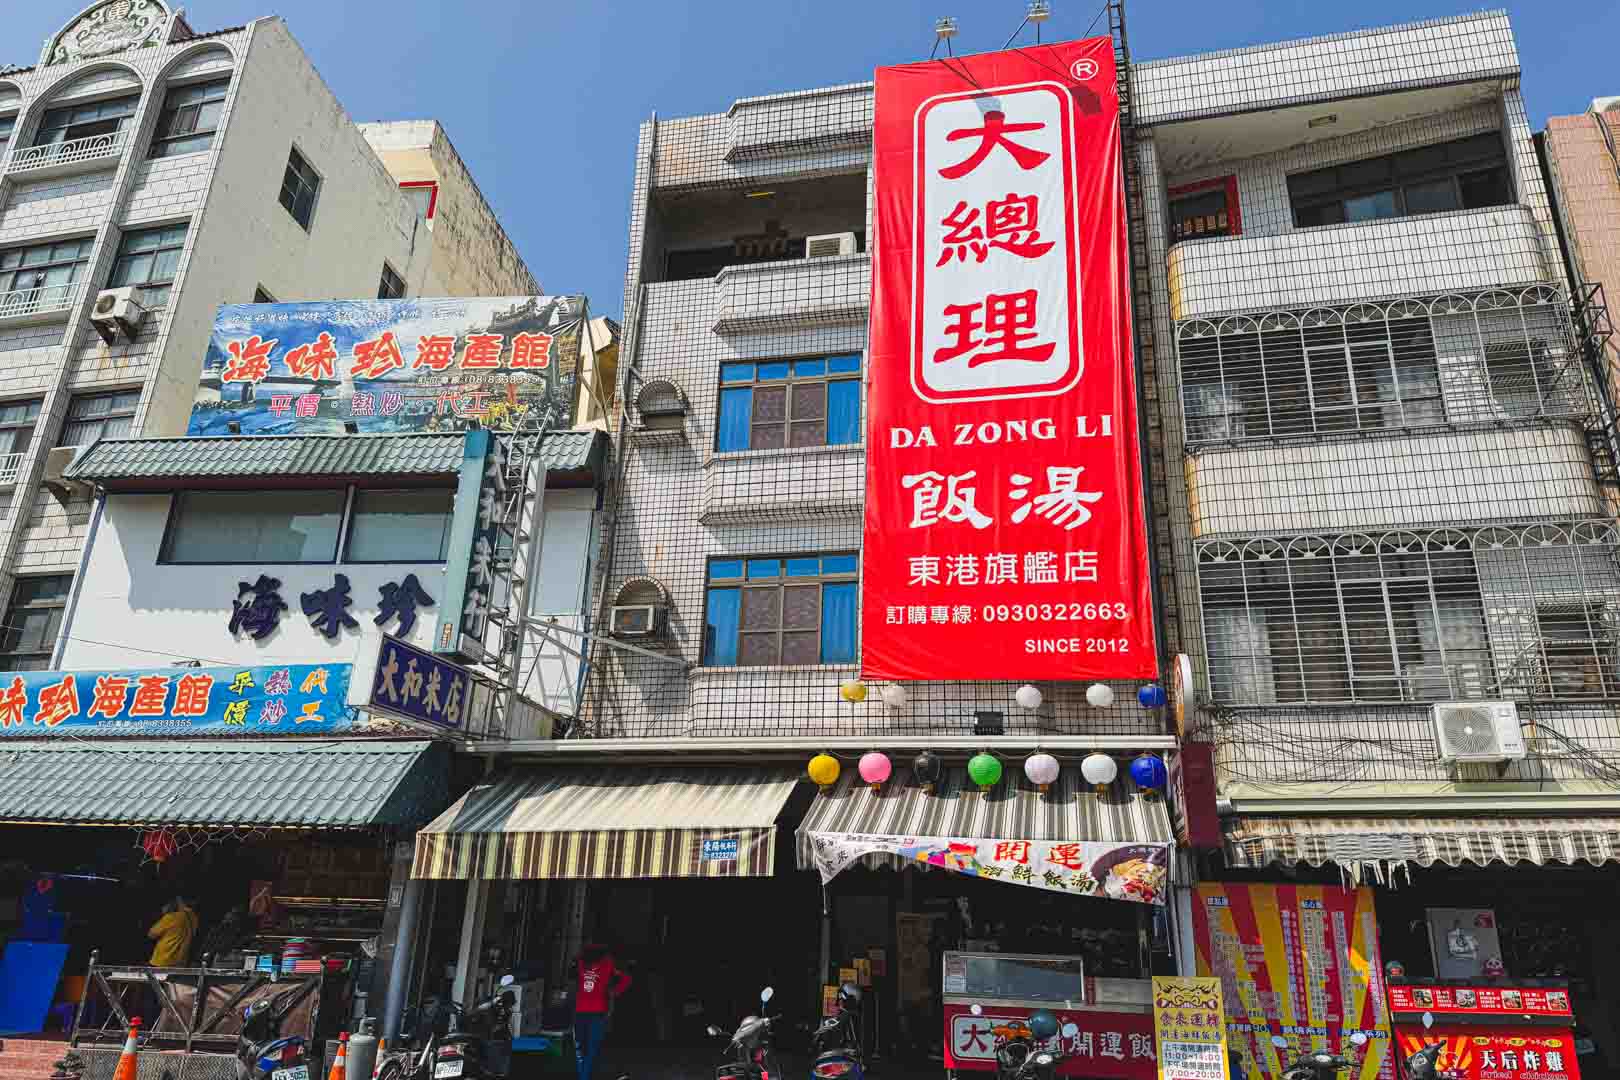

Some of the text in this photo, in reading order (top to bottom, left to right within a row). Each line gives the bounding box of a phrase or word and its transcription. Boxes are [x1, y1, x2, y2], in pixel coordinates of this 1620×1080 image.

[934, 111, 1056, 368] 大總理
[890, 415, 1112, 448] DA ZONG LI
[902, 466, 1103, 530] 飯湯
[908, 550, 1098, 586] 東港旗艦店
[228, 573, 435, 640] 海味珍
[1025, 638, 1129, 653] SINCE 2012
[377, 648, 463, 723] 大和米店
[993, 841, 1084, 871] 開運
